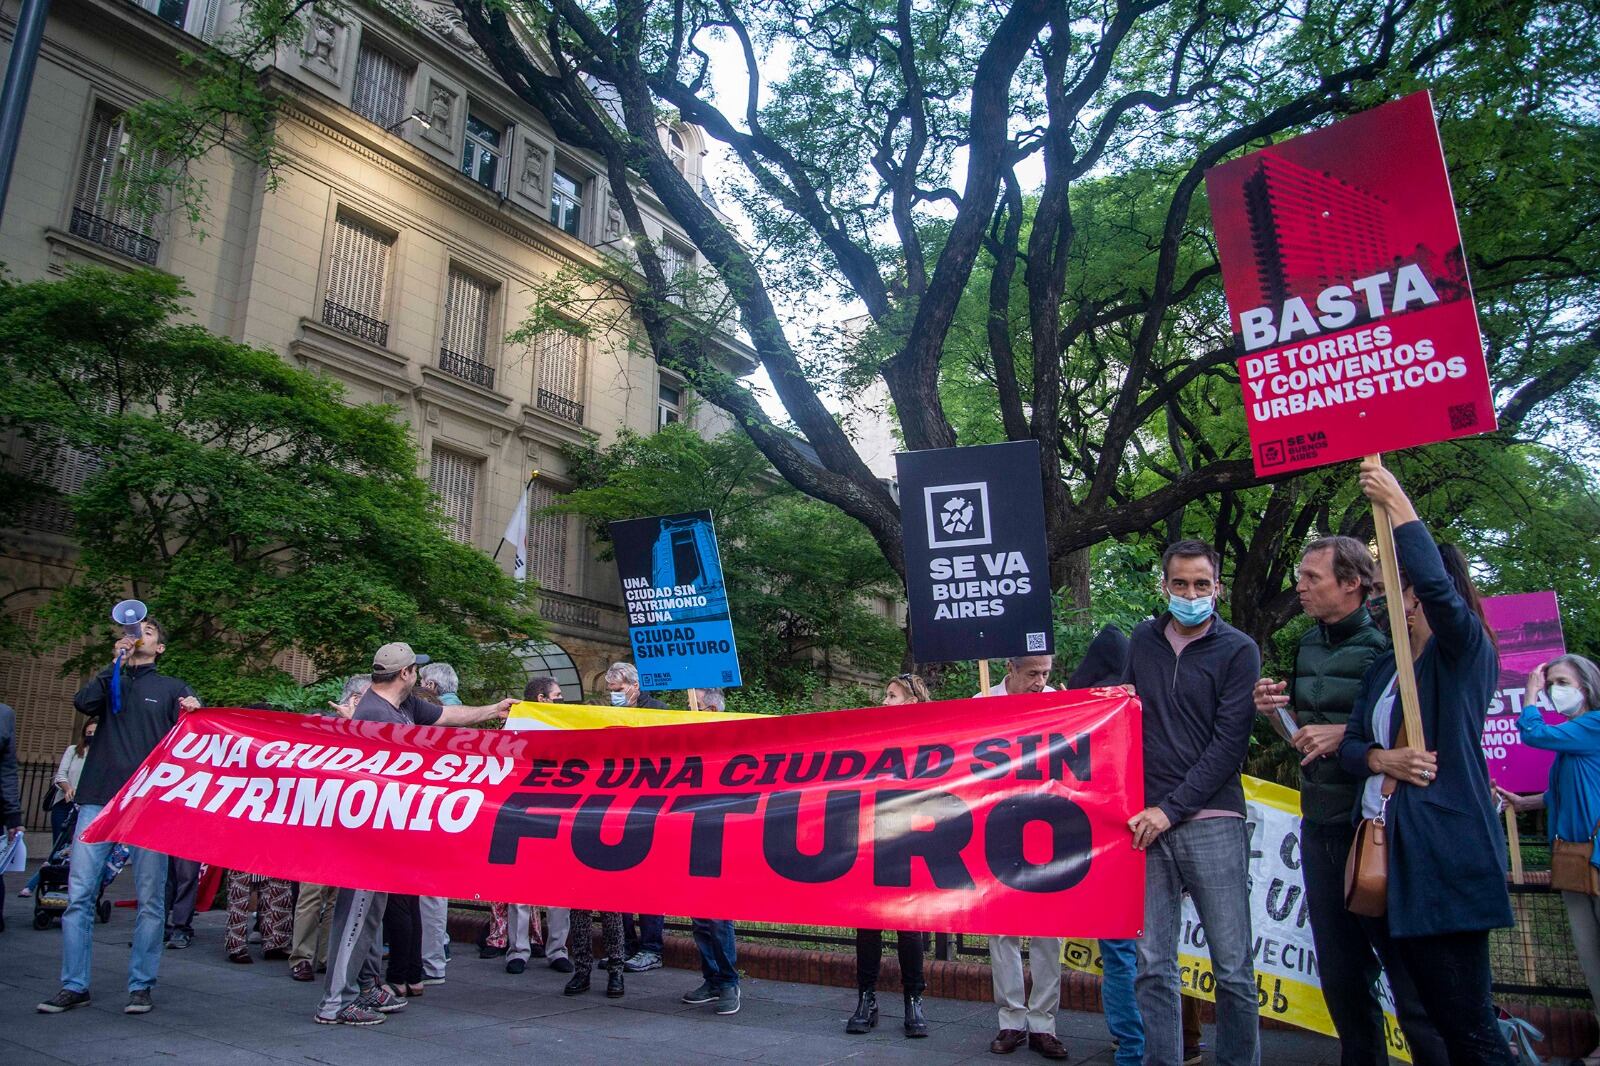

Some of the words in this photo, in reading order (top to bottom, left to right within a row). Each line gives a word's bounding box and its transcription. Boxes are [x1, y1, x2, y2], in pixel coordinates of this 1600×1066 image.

[1239, 263, 1440, 351] BASTA
[1245, 354, 1280, 378] DE
[1283, 325, 1393, 369] TORRES
[1248, 380, 1267, 399] Y
[1271, 339, 1435, 395] CONVENIOS
[1252, 356, 1467, 422] URBANISTICOS
[1287, 435, 1305, 446] SE
[1307, 431, 1327, 443] VA
[1288, 441, 1328, 456] BUENOS
[1289, 451, 1318, 463] AIRES
[929, 555, 977, 580] SE
[982, 551, 1030, 576] VA
[623, 576, 649, 590] UNA
[626, 586, 672, 601] CIUDAD
[673, 584, 696, 596] SIN
[932, 577, 1032, 601] BUENOS
[628, 595, 707, 613] PATRIMONIO
[934, 599, 1005, 620] AIRES
[630, 613, 648, 624] ES
[648, 611, 672, 623] UNA
[634, 627, 695, 644] CIUDAD
[637, 644, 665, 659] SIN
[668, 639, 731, 657] FUTURO
[172, 733, 253, 769] UNA
[256, 741, 425, 777] CIUDAD
[424, 753, 514, 786] SIN
[520, 758, 590, 788] ES
[596, 756, 704, 789] UNA
[719, 744, 955, 786] CIUDAD
[969, 732, 1092, 782] SIN
[134, 762, 484, 833] PATRIMONIO
[488, 788, 1093, 893] FUTURO
